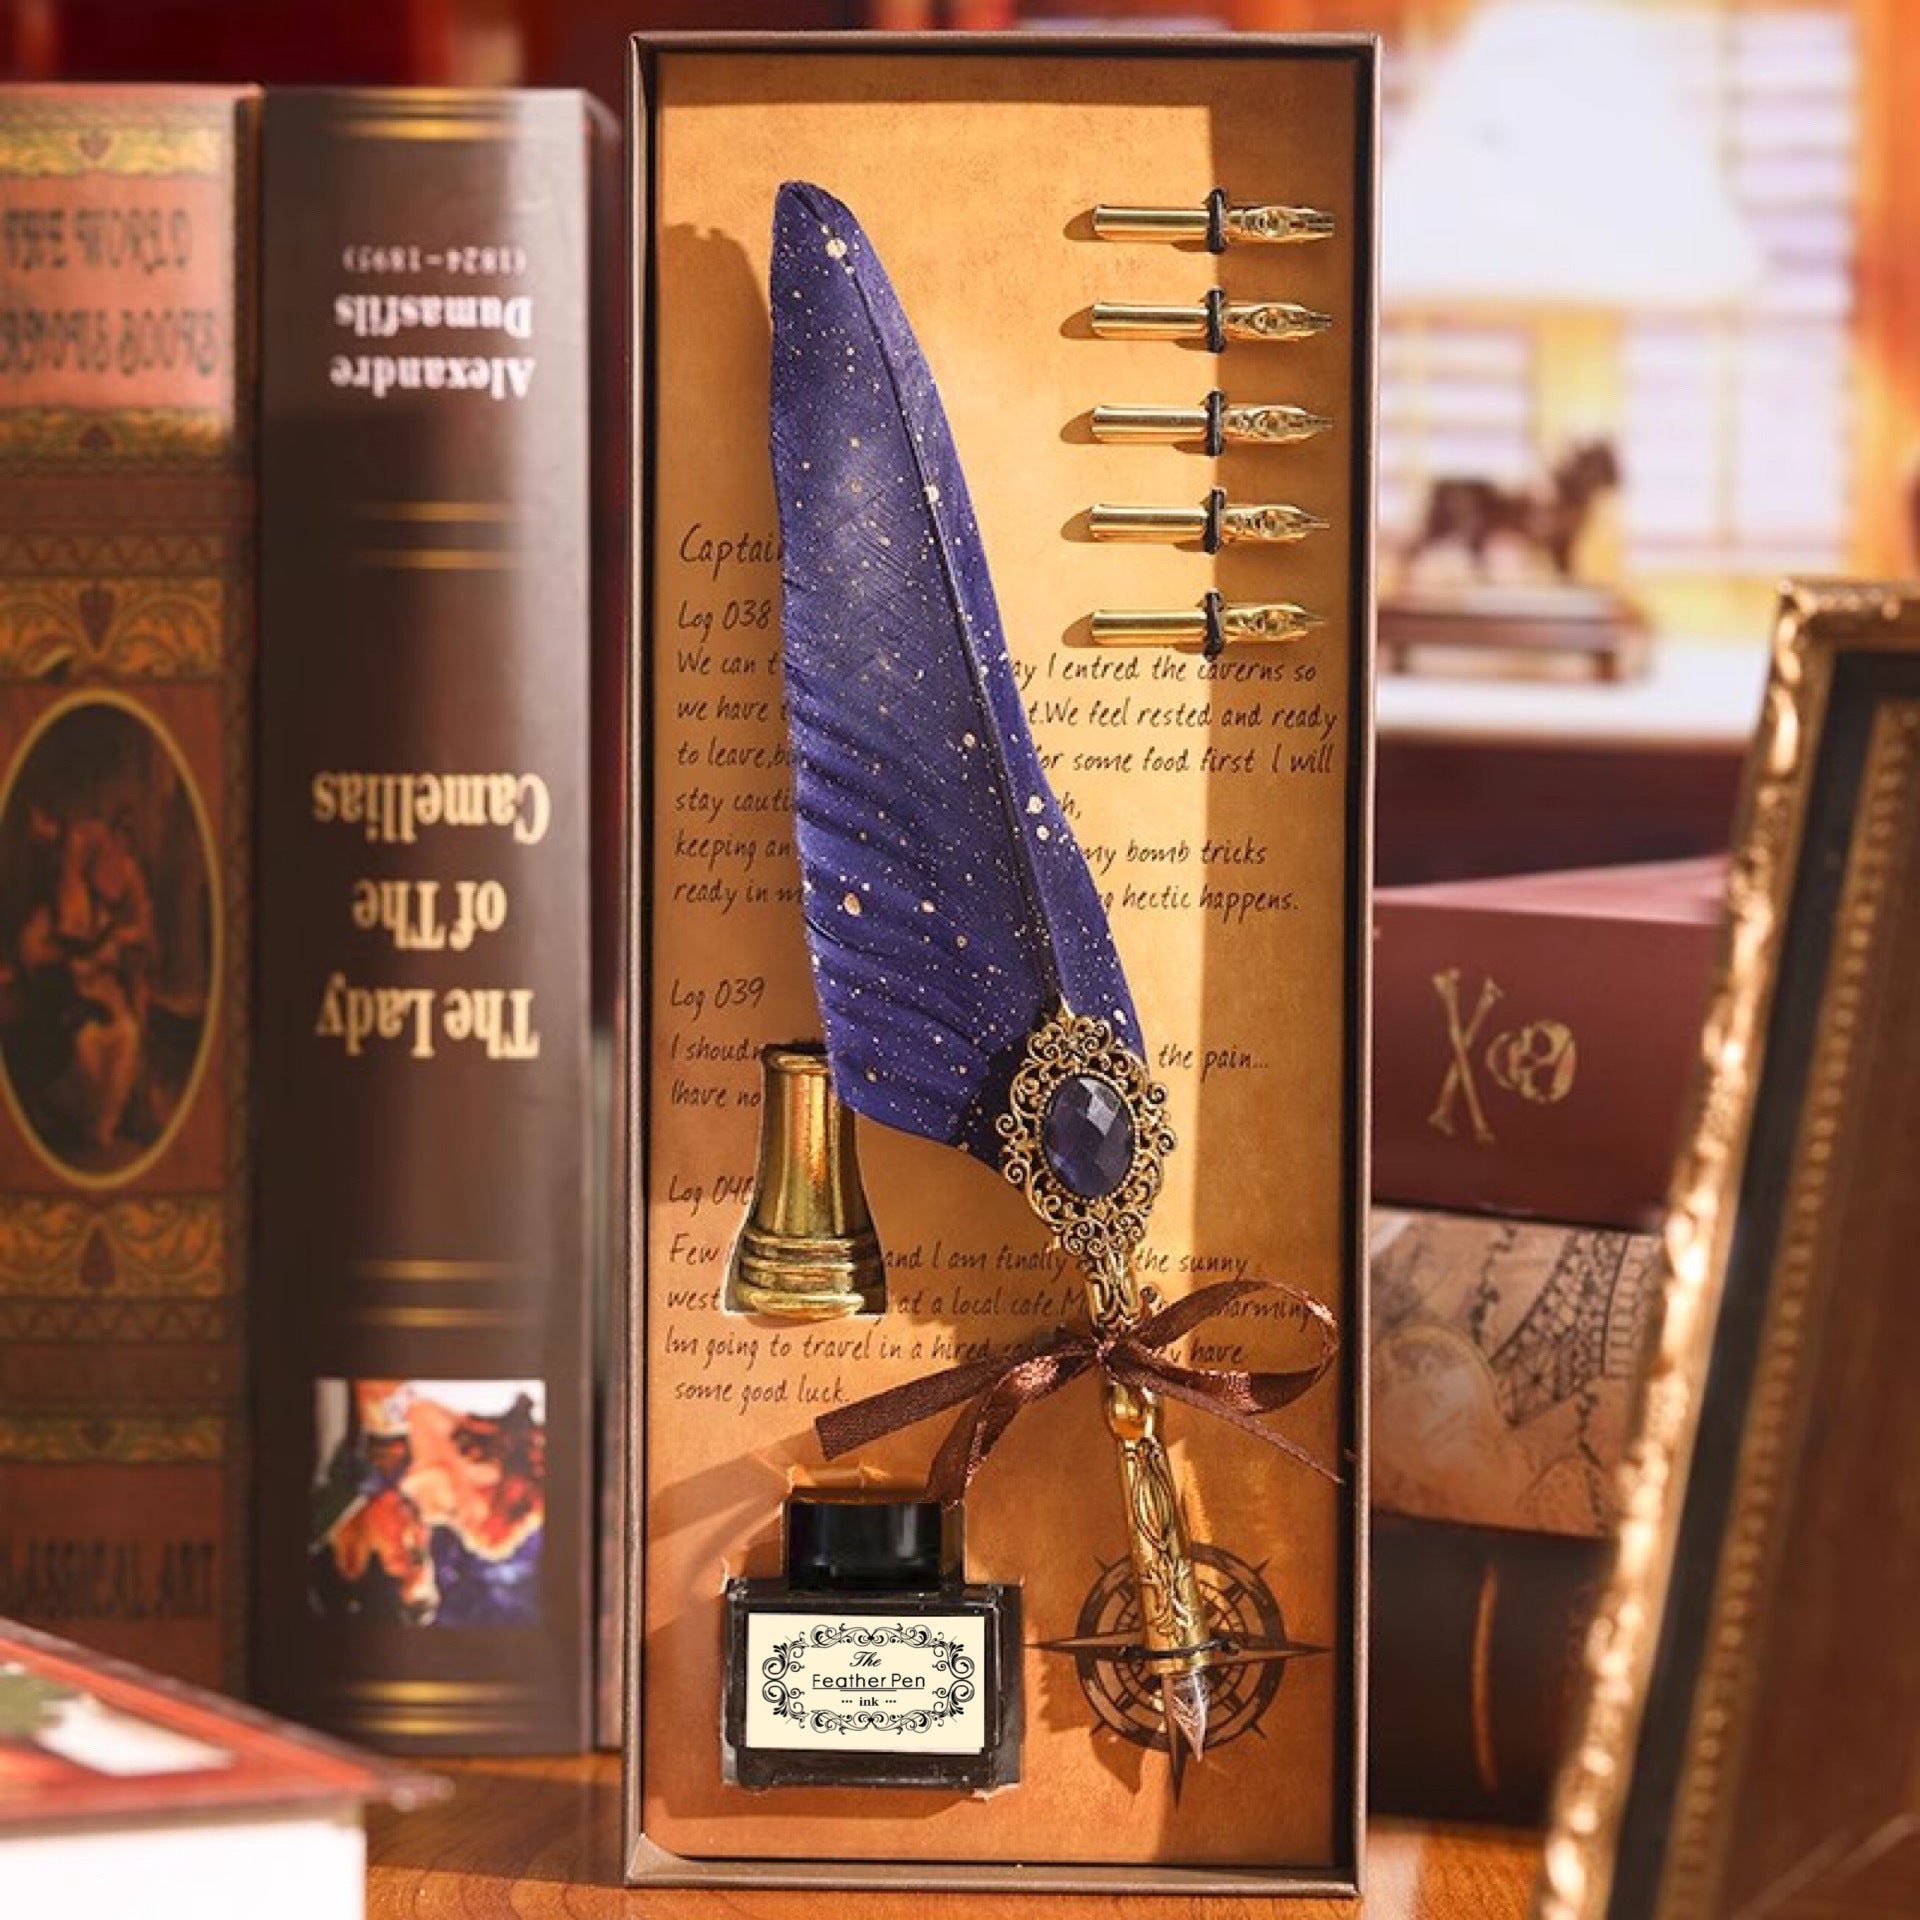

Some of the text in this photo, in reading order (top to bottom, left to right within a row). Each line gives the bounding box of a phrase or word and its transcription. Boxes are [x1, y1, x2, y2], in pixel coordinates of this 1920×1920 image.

[329, 356, 537, 401] Alexandre
[679, 599, 771, 644] Log 038
[678, 645, 711, 675] We
[721, 656, 757, 675] can
[1048, 652, 1057, 679] I
[1062, 655, 1141, 680] entred
[1152, 655, 1187, 681] the
[1198, 660, 1285, 682] caverns
[1294, 664, 1317, 682] so
[679, 700, 708, 721] we
[717, 695, 768, 722] have
[1089, 696, 1132, 727] feel
[1137, 702, 1213, 728] rested
[1221, 702, 1263, 728] and
[1271, 703, 1338, 742] ready
[678, 740, 700, 767] to
[1073, 752, 1134, 773] some
[1142, 746, 1190, 773] food
[1199, 745, 1255, 774] first
[1290, 743, 1335, 774] will
[312, 771, 550, 846] Camellias
[675, 786, 793, 824] stay cauti
[674, 829, 758, 872] keeping
[1126, 838, 1191, 864] bomb
[1201, 836, 1269, 865] tricks
[674, 878, 738, 915] ready
[745, 879, 769, 903] in
[1121, 883, 1193, 911] hectic
[1200, 884, 1301, 924] happens.
[353, 879, 508, 952] of The
[671, 976, 765, 1021] Log 039
[316, 971, 541, 1060] The Lady
[1158, 1044, 1193, 1070] the
[669, 1176, 703, 1218] Log
[669, 1232, 721, 1266] Few
[885, 1245, 922, 1269] and
[948, 1251, 988, 1270] am
[995, 1243, 1069, 1283] finally
[1135, 1249, 1250, 1280] the sunny
[667, 1290, 721, 1312] west
[898, 1290, 924, 1315] at
[930, 1295, 943, 1315] a
[952, 1286, 1002, 1316] local
[1012, 1291, 1054, 1316] cafe
[770, 1334, 792, 1357] to
[802, 1329, 872, 1361] travel
[880, 1335, 902, 1359] in
[911, 1341, 922, 1359] a
[930, 1333, 991, 1360] hired
[1190, 1337, 1244, 1364] have
[675, 1374, 850, 1416] some good luck.
[850, 1651, 882, 1668] The
[812, 1673, 926, 1688] Feather Pen
[859, 1696, 880, 1707] ink
